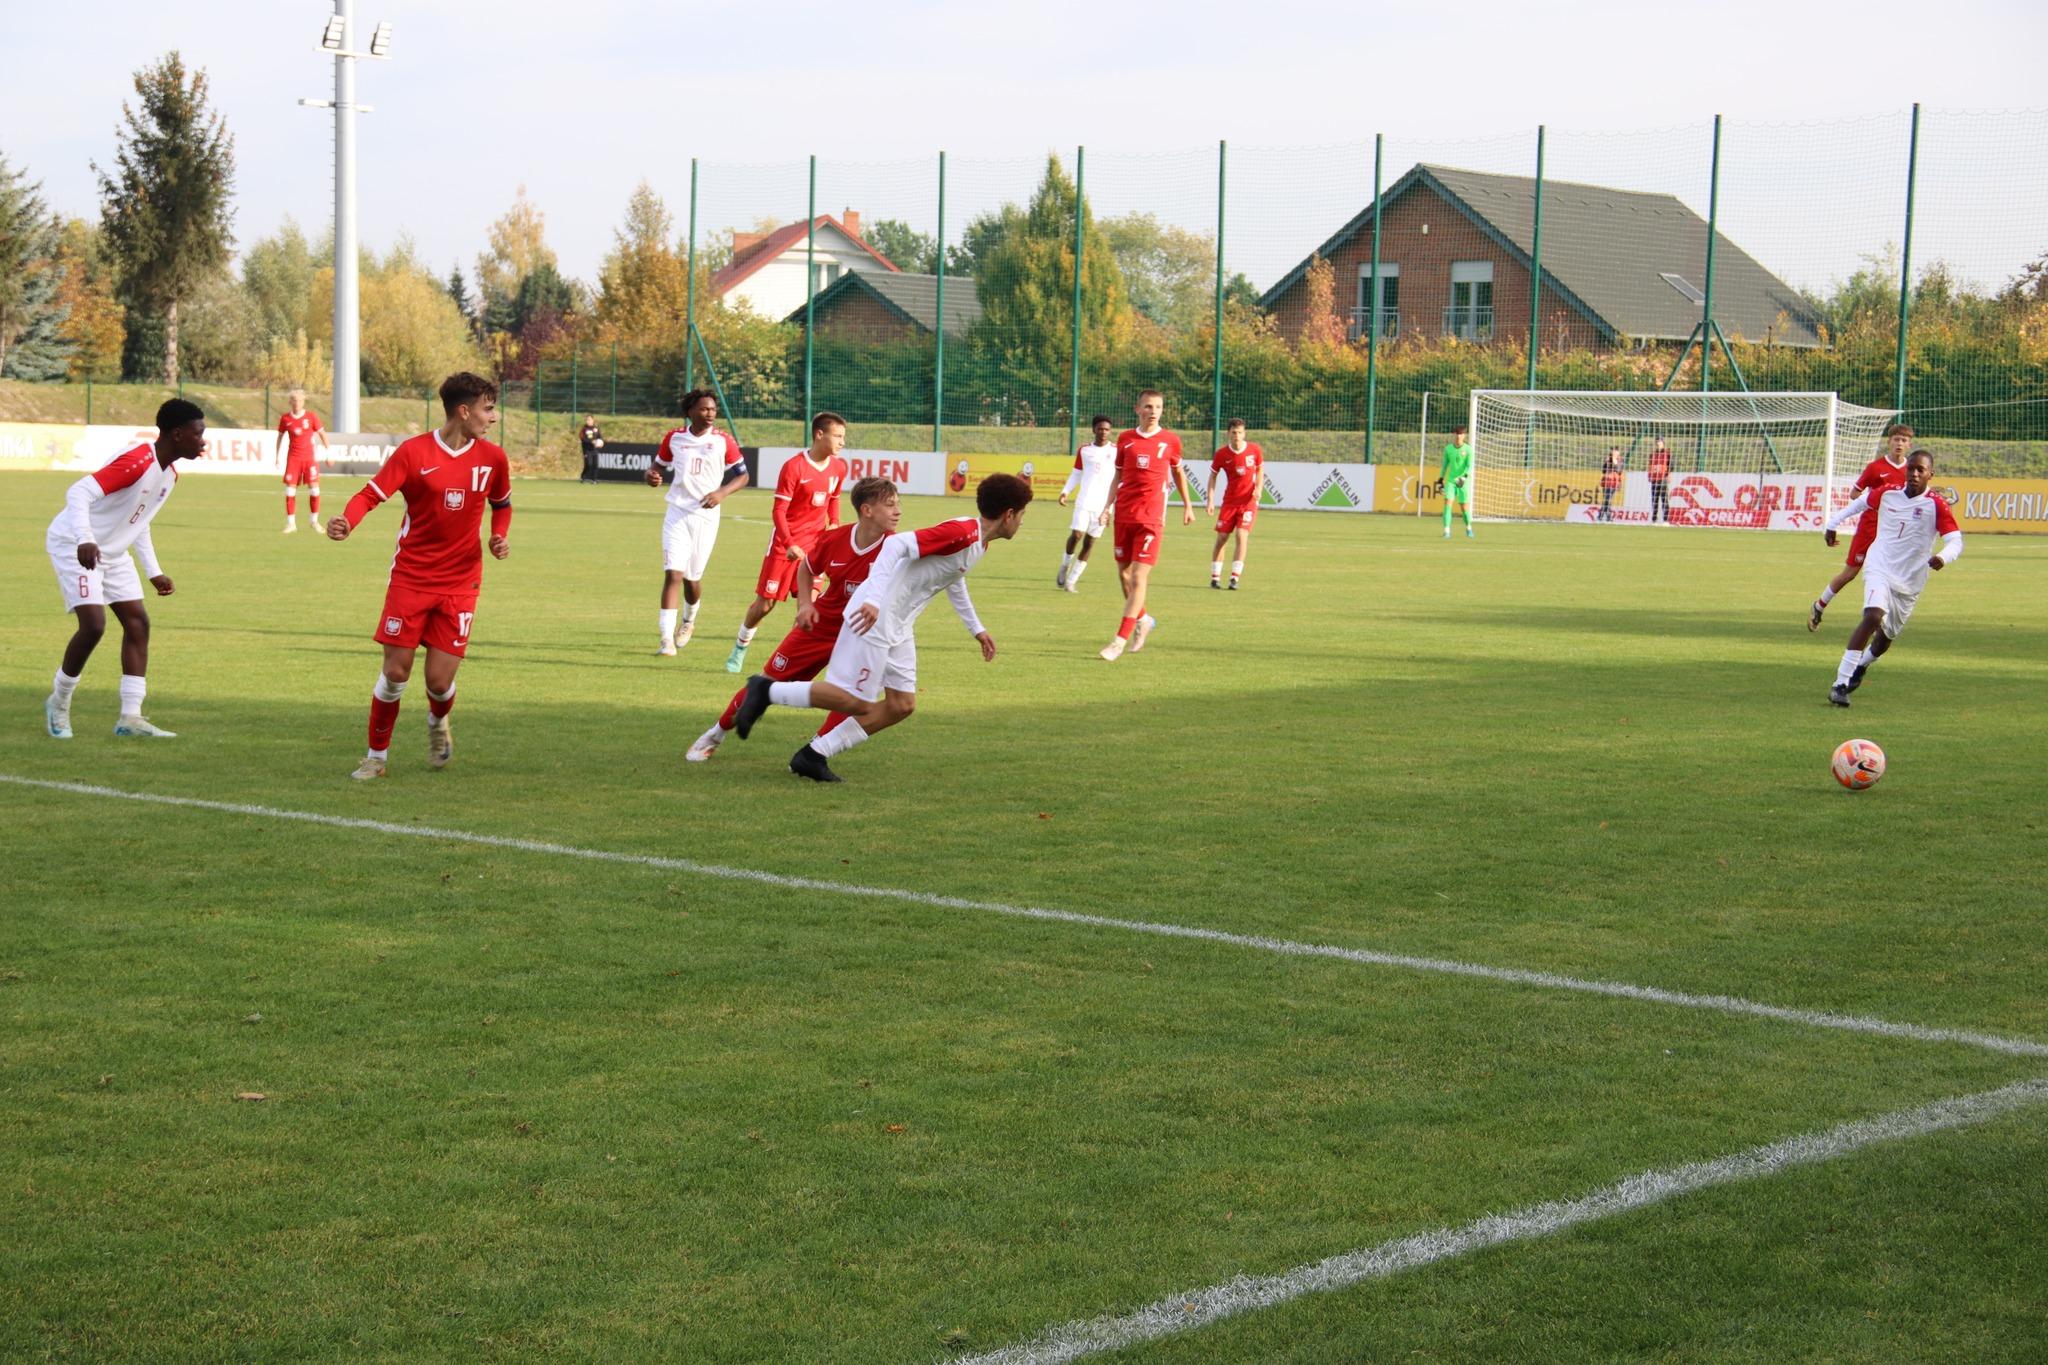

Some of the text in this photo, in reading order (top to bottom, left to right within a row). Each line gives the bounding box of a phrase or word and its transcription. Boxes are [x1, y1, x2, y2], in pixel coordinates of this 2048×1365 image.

[302, 419, 309, 429] 5
[200, 439, 262, 462] RLEN
[1157, 442, 1168, 459] 7
[1245, 454, 1254, 467] 15
[690, 457, 703, 475] 10
[471, 466, 493, 492] 17
[1307, 468, 1361, 506] LEROY MERLIN
[1415, 480, 1443, 500] InP
[1538, 484, 1601, 505] InPost
[130, 503, 146, 524] 6
[1242, 511, 1253, 522] 15
[1707, 511, 1753, 524] ORLEN
[1898, 521, 1906, 539] 7
[1142, 535, 1154, 551] 7
[79, 575, 89, 598] 6
[458, 612, 474, 637] 17
[855, 668, 871, 692] 2
